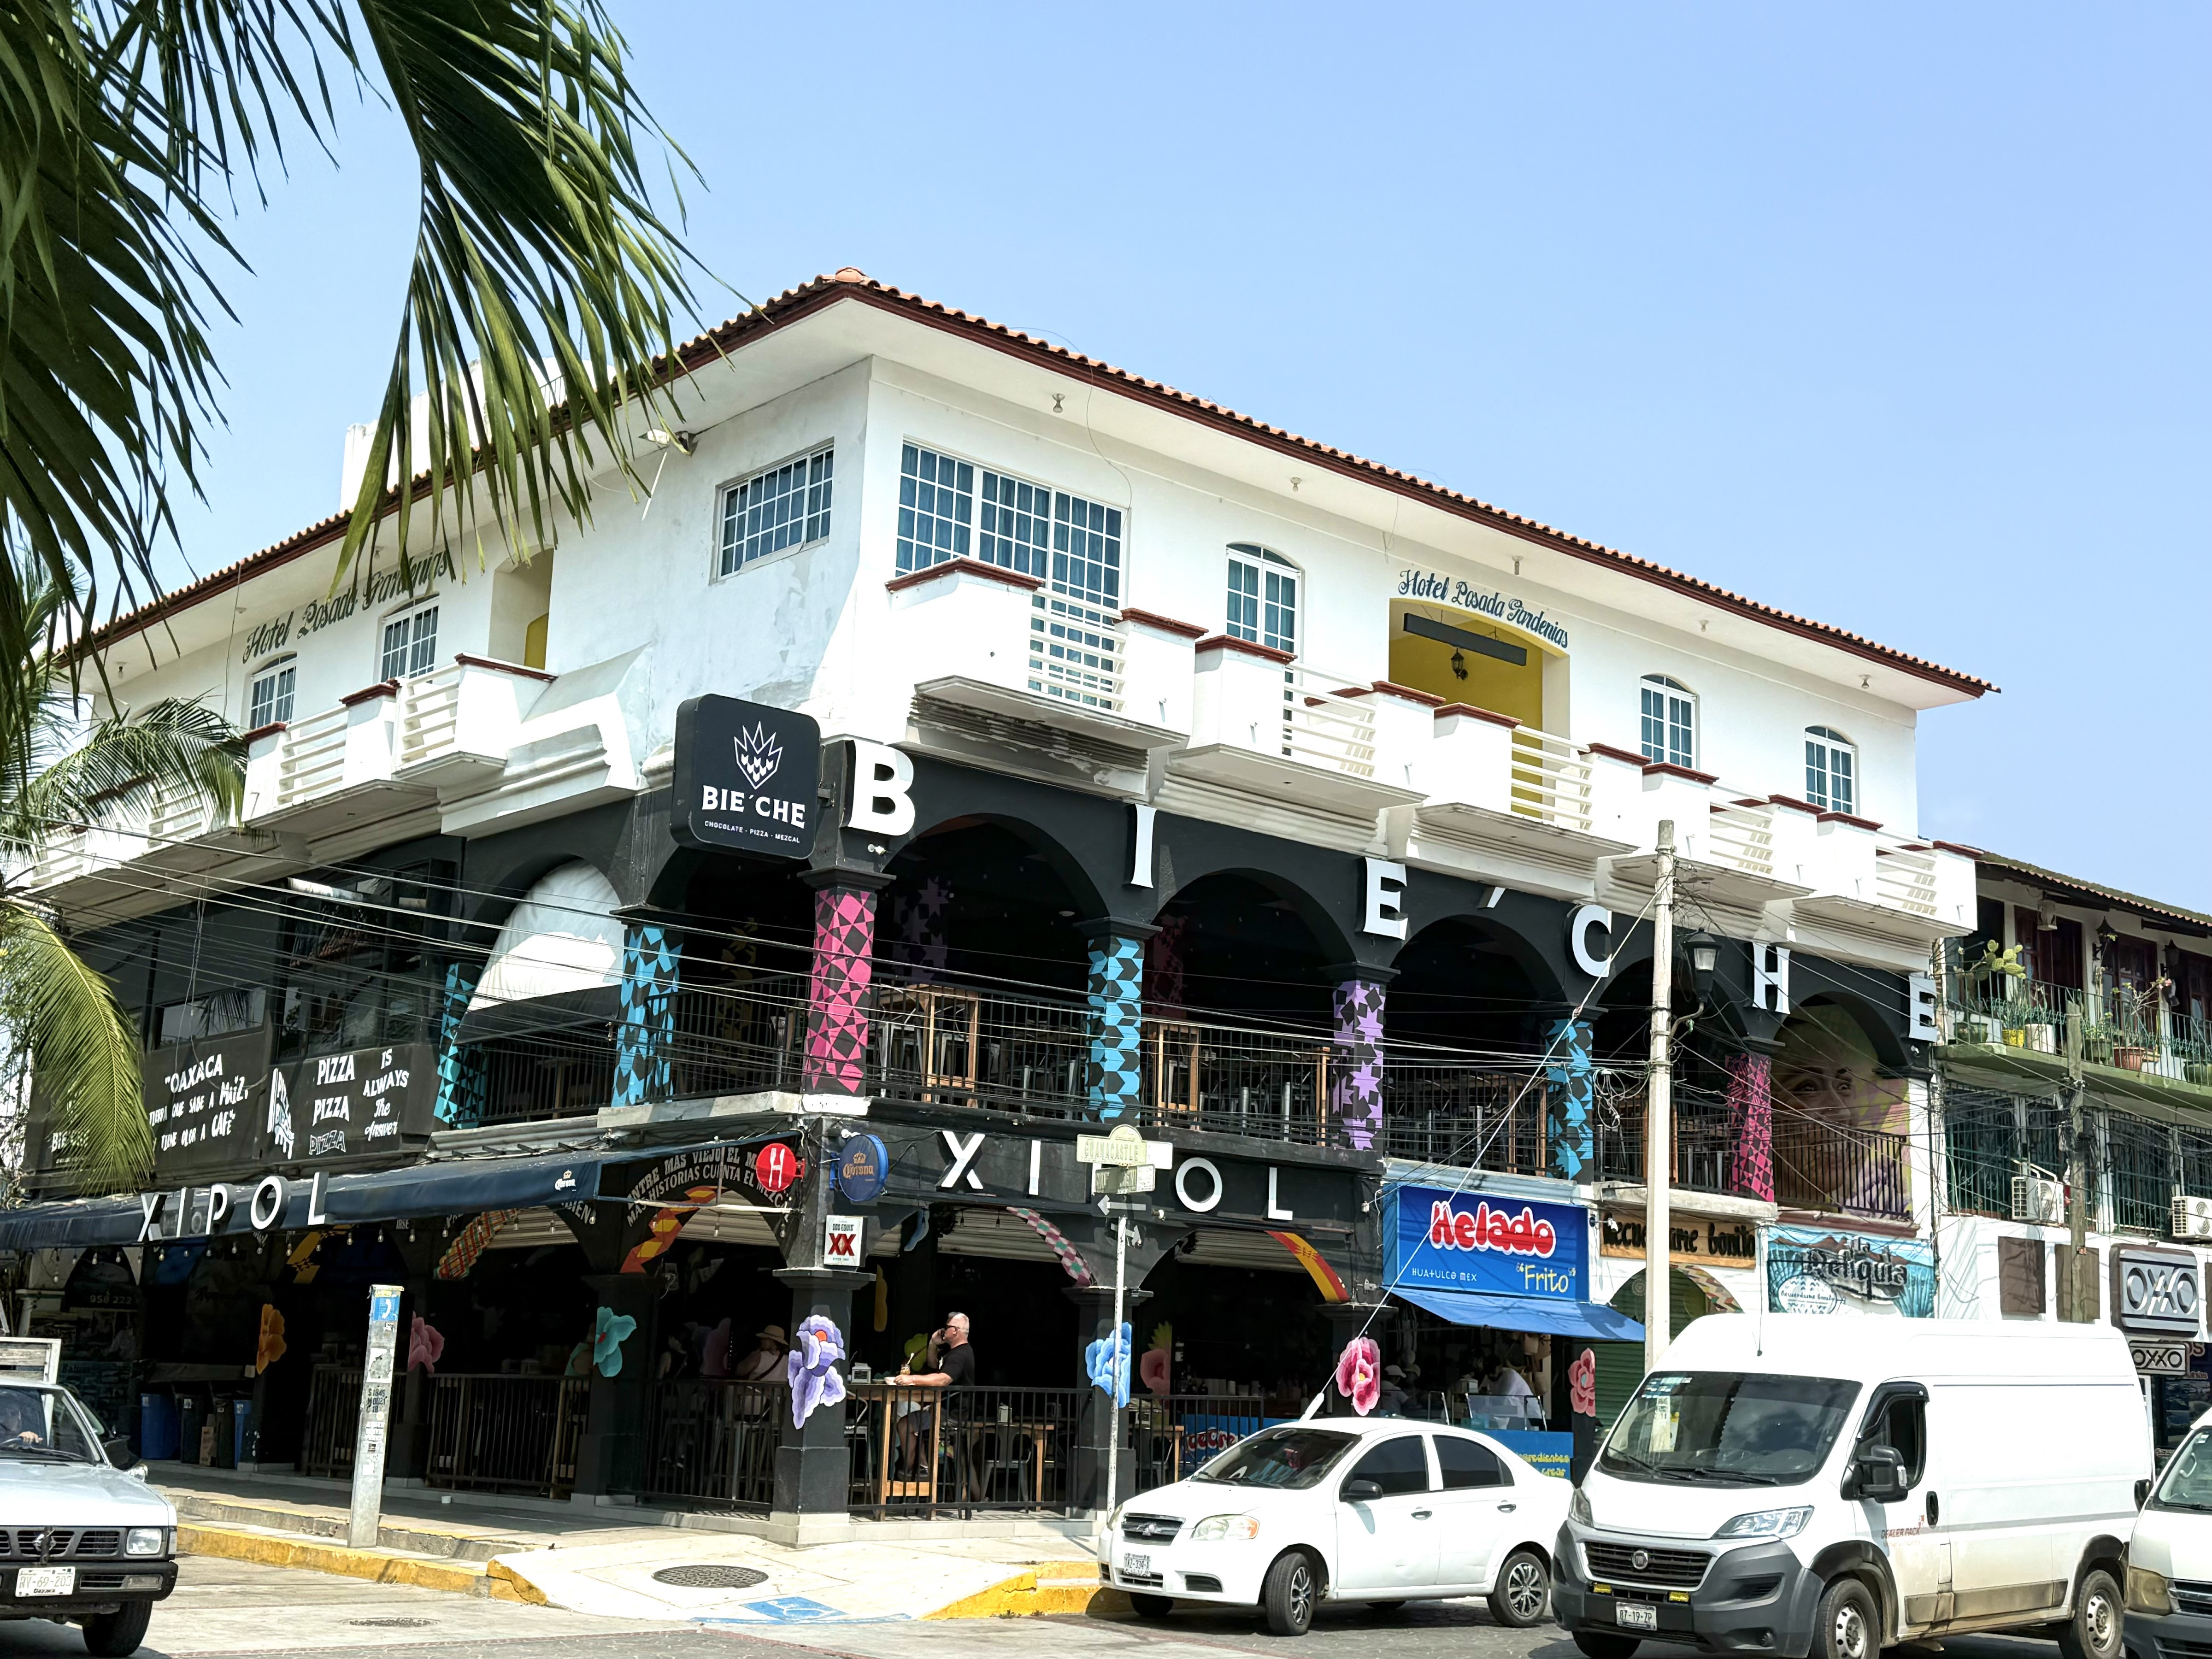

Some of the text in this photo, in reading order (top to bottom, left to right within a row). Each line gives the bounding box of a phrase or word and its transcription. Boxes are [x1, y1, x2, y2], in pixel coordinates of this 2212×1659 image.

[1398, 570, 1568, 648] Hotel Posada Gardenias
[242, 611, 294, 664] Hotel
[705, 821, 800, 843] CHOCOLATE PIZZA MEZCAL
[317, 1049, 392, 1085] PIZZA IS
[172, 1101, 184, 1118] QUE
[189, 1095, 204, 1113] SABE
[209, 1091, 214, 1109] A
[312, 1096, 349, 1126] PIZZA
[363, 1070, 409, 1097] ALWAYS
[181, 1127, 197, 1147] OLOR
[200, 1124, 206, 1141] A
[309, 1098, 390, 1155] PIZZA The
[665, 1153, 686, 1174] MAS
[727, 1147, 740, 1164] EL
[843, 1163, 874, 1179] Corona
[941, 1131, 1293, 1221] XIOL
[555, 1178, 576, 1191] Corona
[647, 1165, 700, 1201] HISTORIAS
[744, 1171, 754, 1187] EL
[137, 1172, 328, 1242] XIPOL
[828, 1233, 856, 1256] XX
[1430, 1201, 1556, 1258] Helado
[1708, 1222, 1755, 1257] bonito
[1460, 1273, 1477, 1281] MEX
[2127, 1267, 2197, 1315] OXXO
[2132, 1349, 2182, 1369] OXXO
